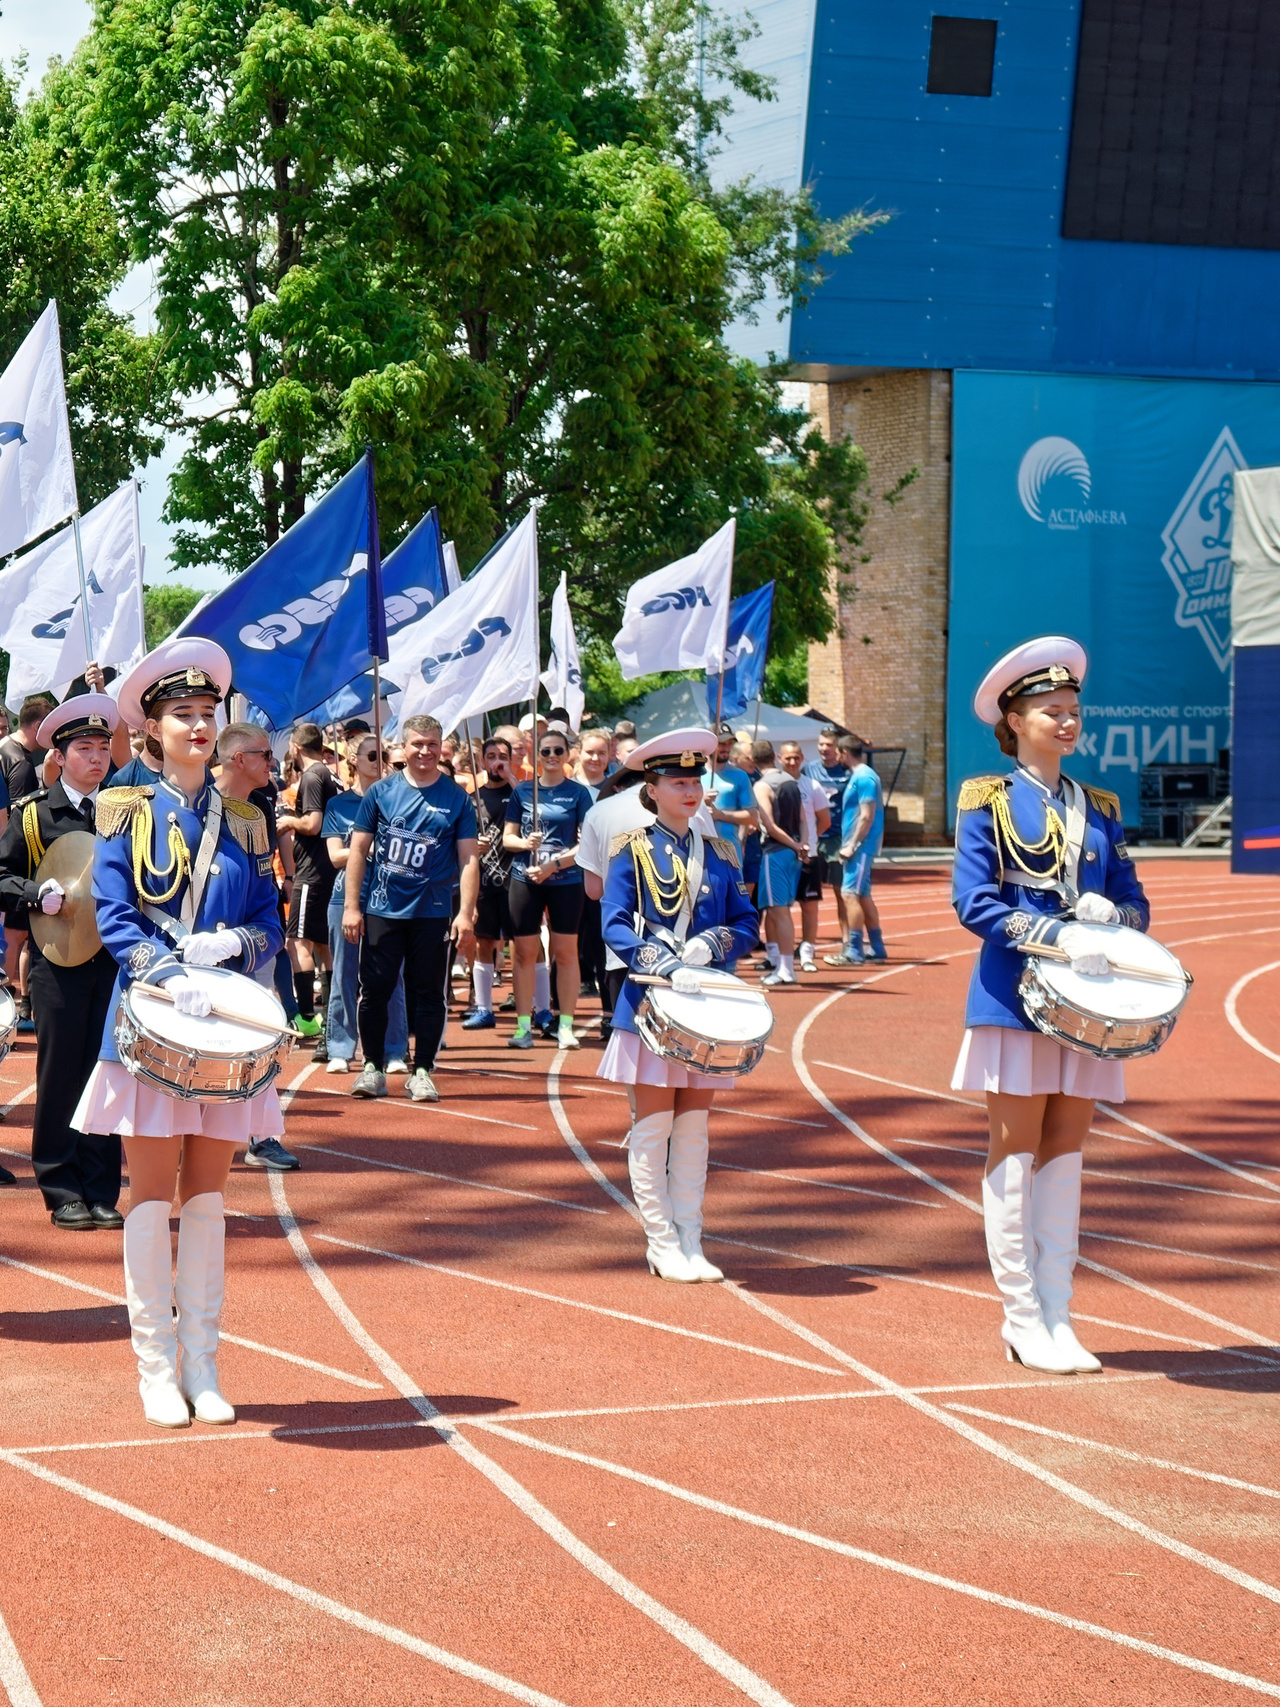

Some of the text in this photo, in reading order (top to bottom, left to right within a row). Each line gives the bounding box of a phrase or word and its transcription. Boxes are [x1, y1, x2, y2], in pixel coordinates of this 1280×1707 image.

[1048, 508, 1127, 525] АСТАФЬЕВА
[1185, 594, 1231, 616] ДИН
[1083, 706, 1179, 717] ПРИМОРСКОЕ
[1075, 725, 1233, 773] «ДИН
[388, 837, 427, 868] 018
